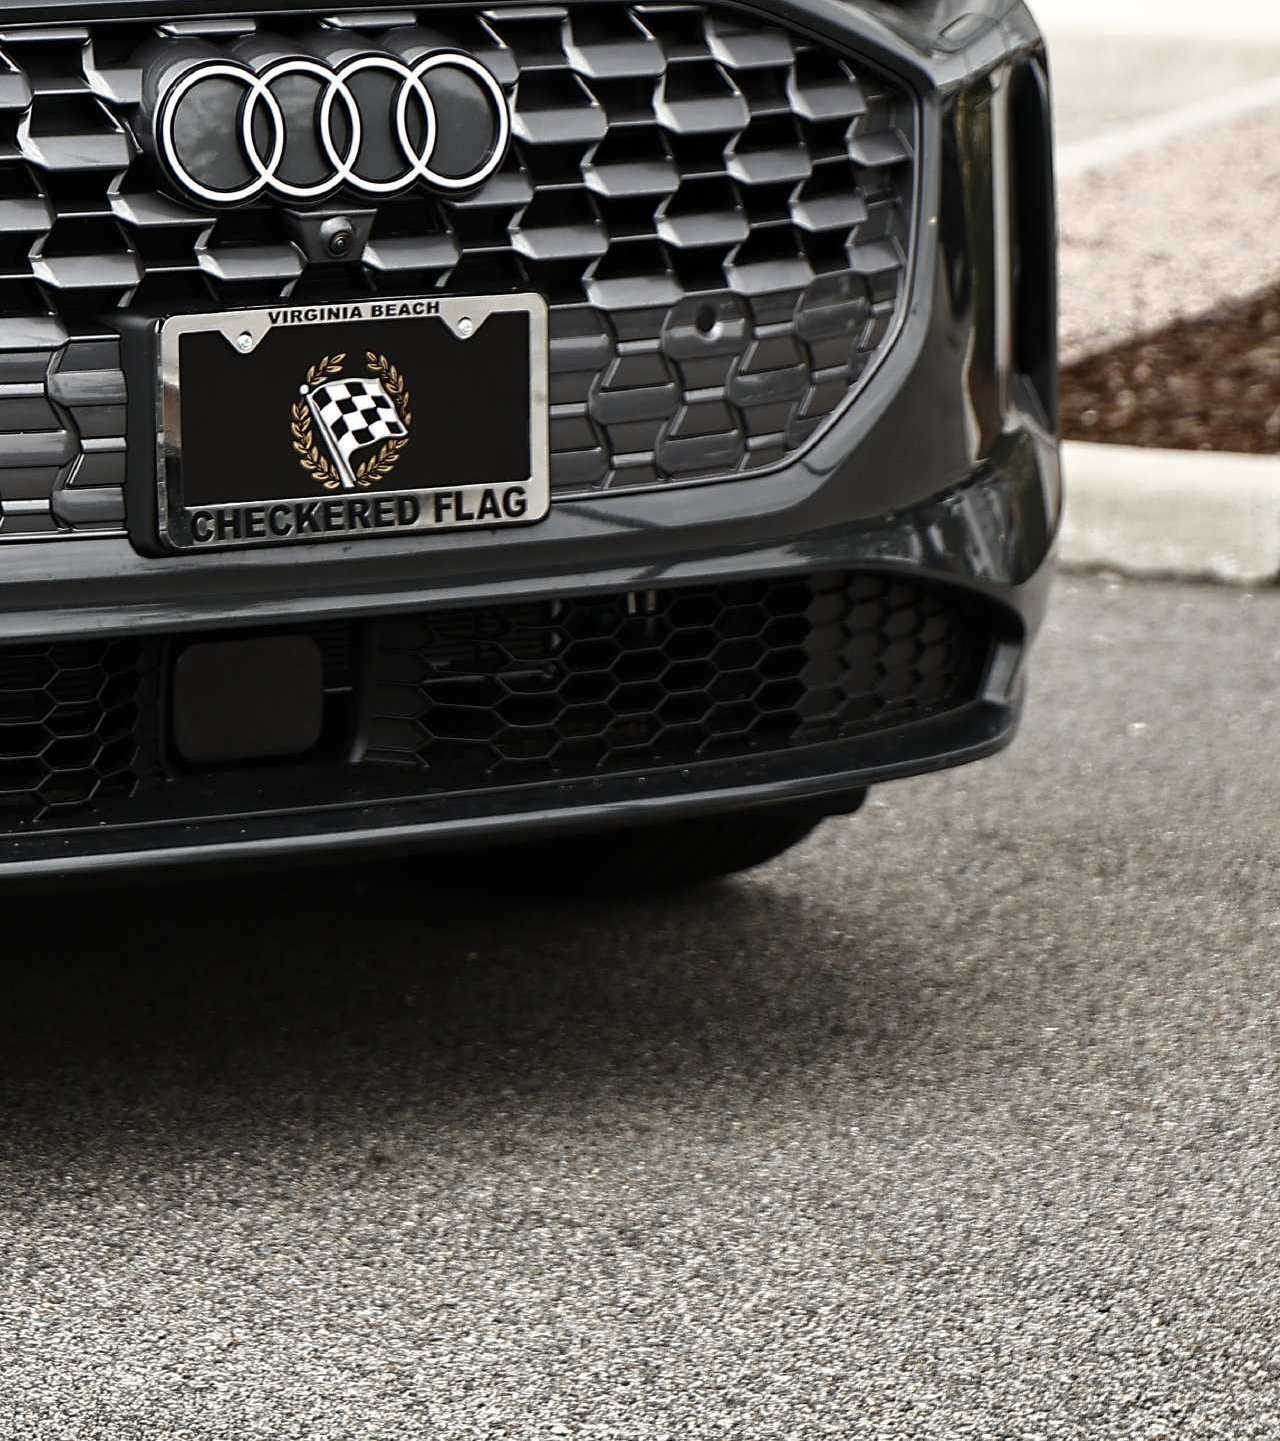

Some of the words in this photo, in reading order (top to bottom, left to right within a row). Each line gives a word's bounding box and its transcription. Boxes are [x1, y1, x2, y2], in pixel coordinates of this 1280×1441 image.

[268, 306, 363, 326] VIRGINIA
[370, 300, 441, 319] BEACH
[190, 493, 421, 544] CHECKERED
[433, 485, 528, 524] FLAG
